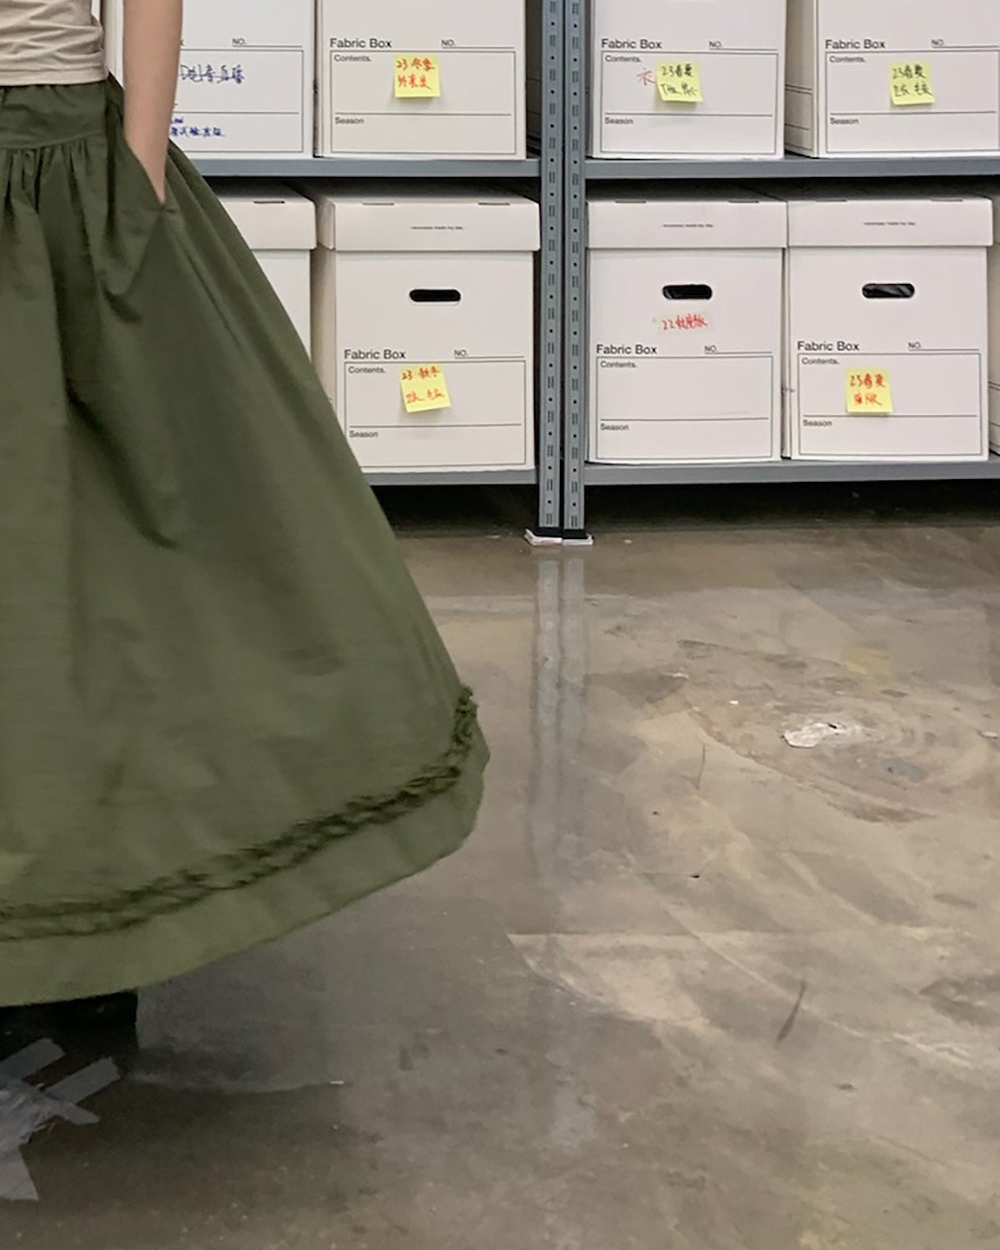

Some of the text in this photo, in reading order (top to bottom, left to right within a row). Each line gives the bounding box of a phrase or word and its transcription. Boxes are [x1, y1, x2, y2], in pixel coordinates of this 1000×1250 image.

[330, 38, 392, 48] Fabric Box
[601, 39, 662, 49] Fabric Box
[825, 39, 886, 49] Fabric Box
[334, 54, 372, 62] Contents.
[605, 55, 642, 63] Contents.
[335, 117, 365, 125] Season
[596, 344, 658, 354] Fabric Box
[797, 341, 860, 351] Fabric Box
[344, 349, 406, 359] Fabric Box
[348, 366, 386, 374] Contents.
[803, 419, 832, 427] Season
